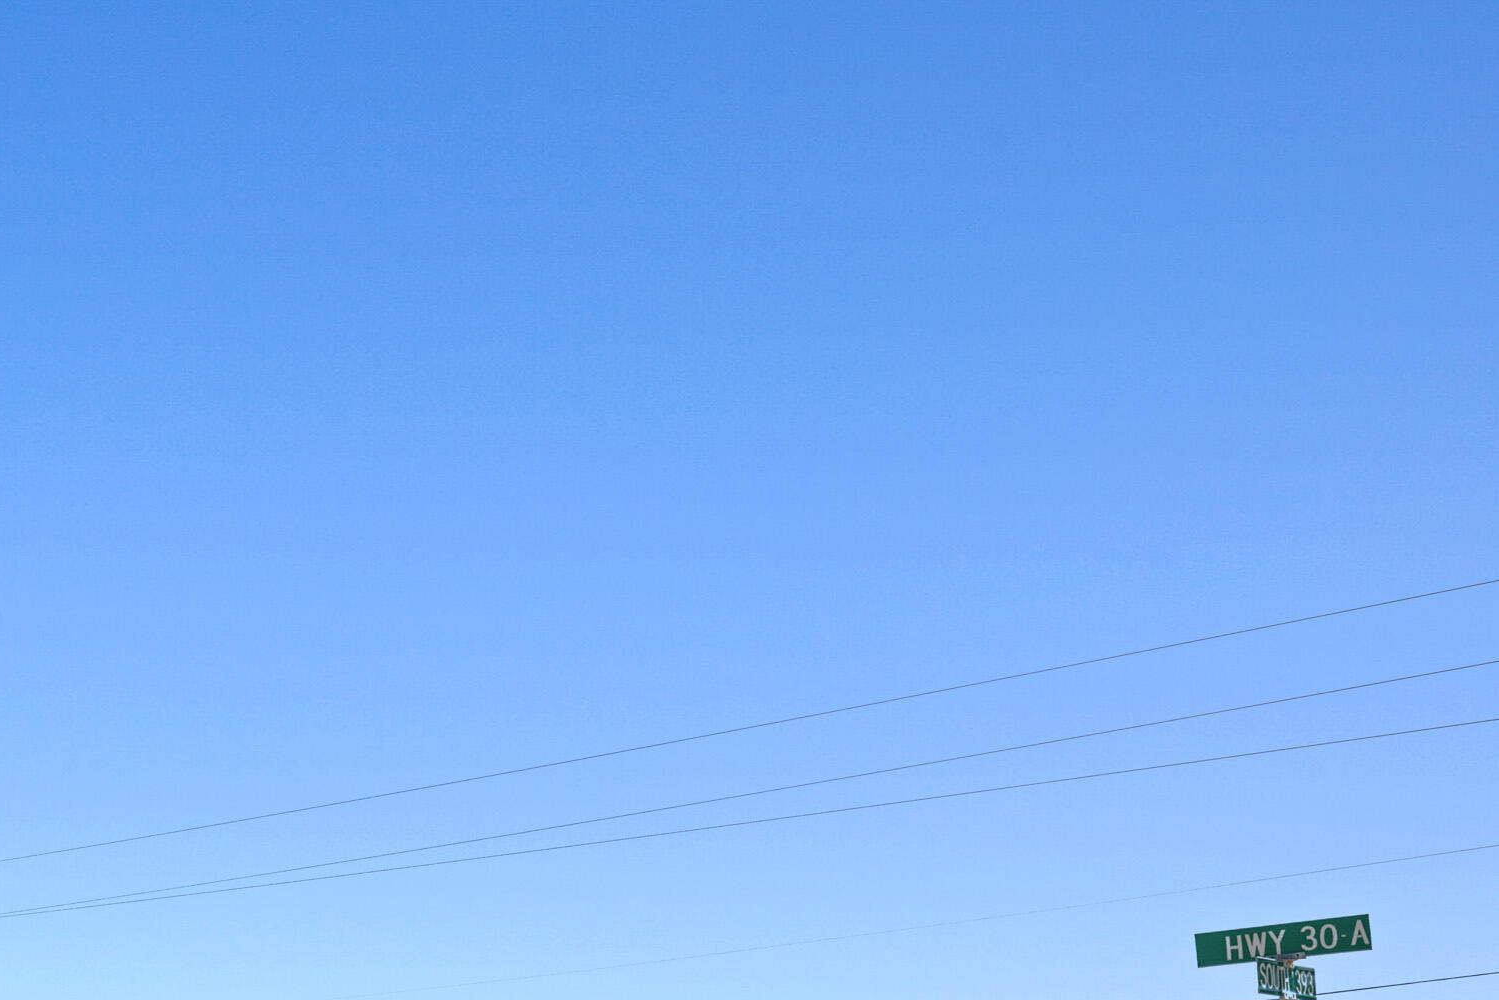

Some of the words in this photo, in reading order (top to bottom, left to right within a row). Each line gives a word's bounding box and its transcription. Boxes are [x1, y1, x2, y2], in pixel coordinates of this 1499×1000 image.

[1225, 929, 1286, 961] HWY
[1300, 919, 1370, 951] 30-A
[1259, 962, 1291, 993] SOUTH
[1295, 969, 1315, 996] 393
